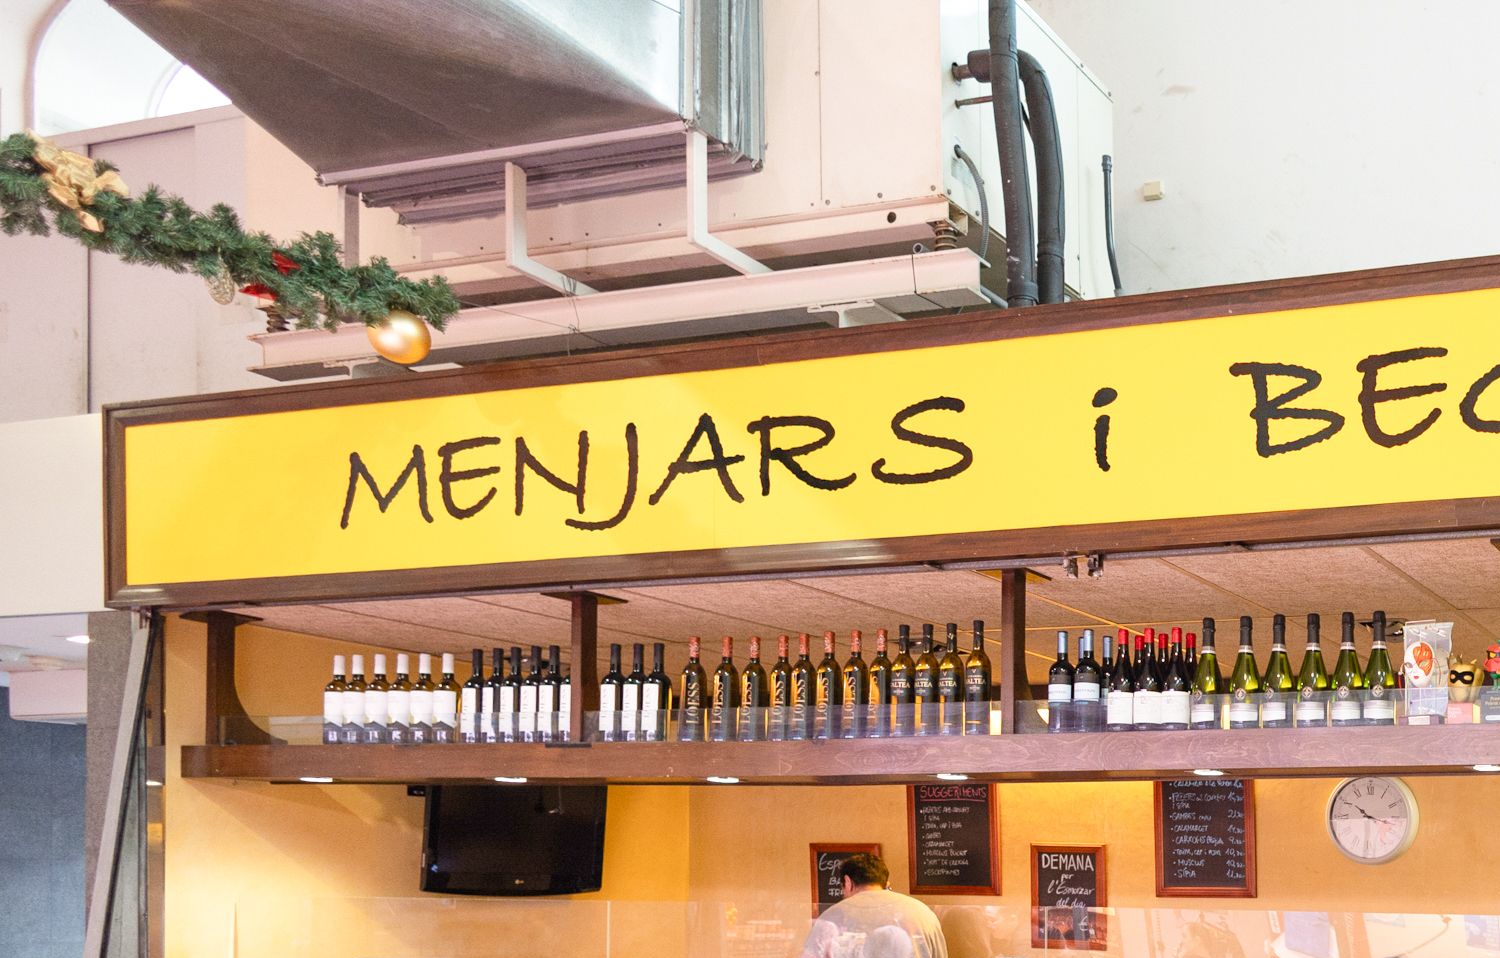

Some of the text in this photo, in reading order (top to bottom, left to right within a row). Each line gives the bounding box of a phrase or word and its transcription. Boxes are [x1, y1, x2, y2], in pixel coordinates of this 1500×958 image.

[340, 396, 973, 532] MENJARS
[1091, 387, 1118, 472] i
[686, 681, 700, 724] LOESS
[1041, 853, 1094, 872] DEMANA
[1061, 873, 1074, 882] per
